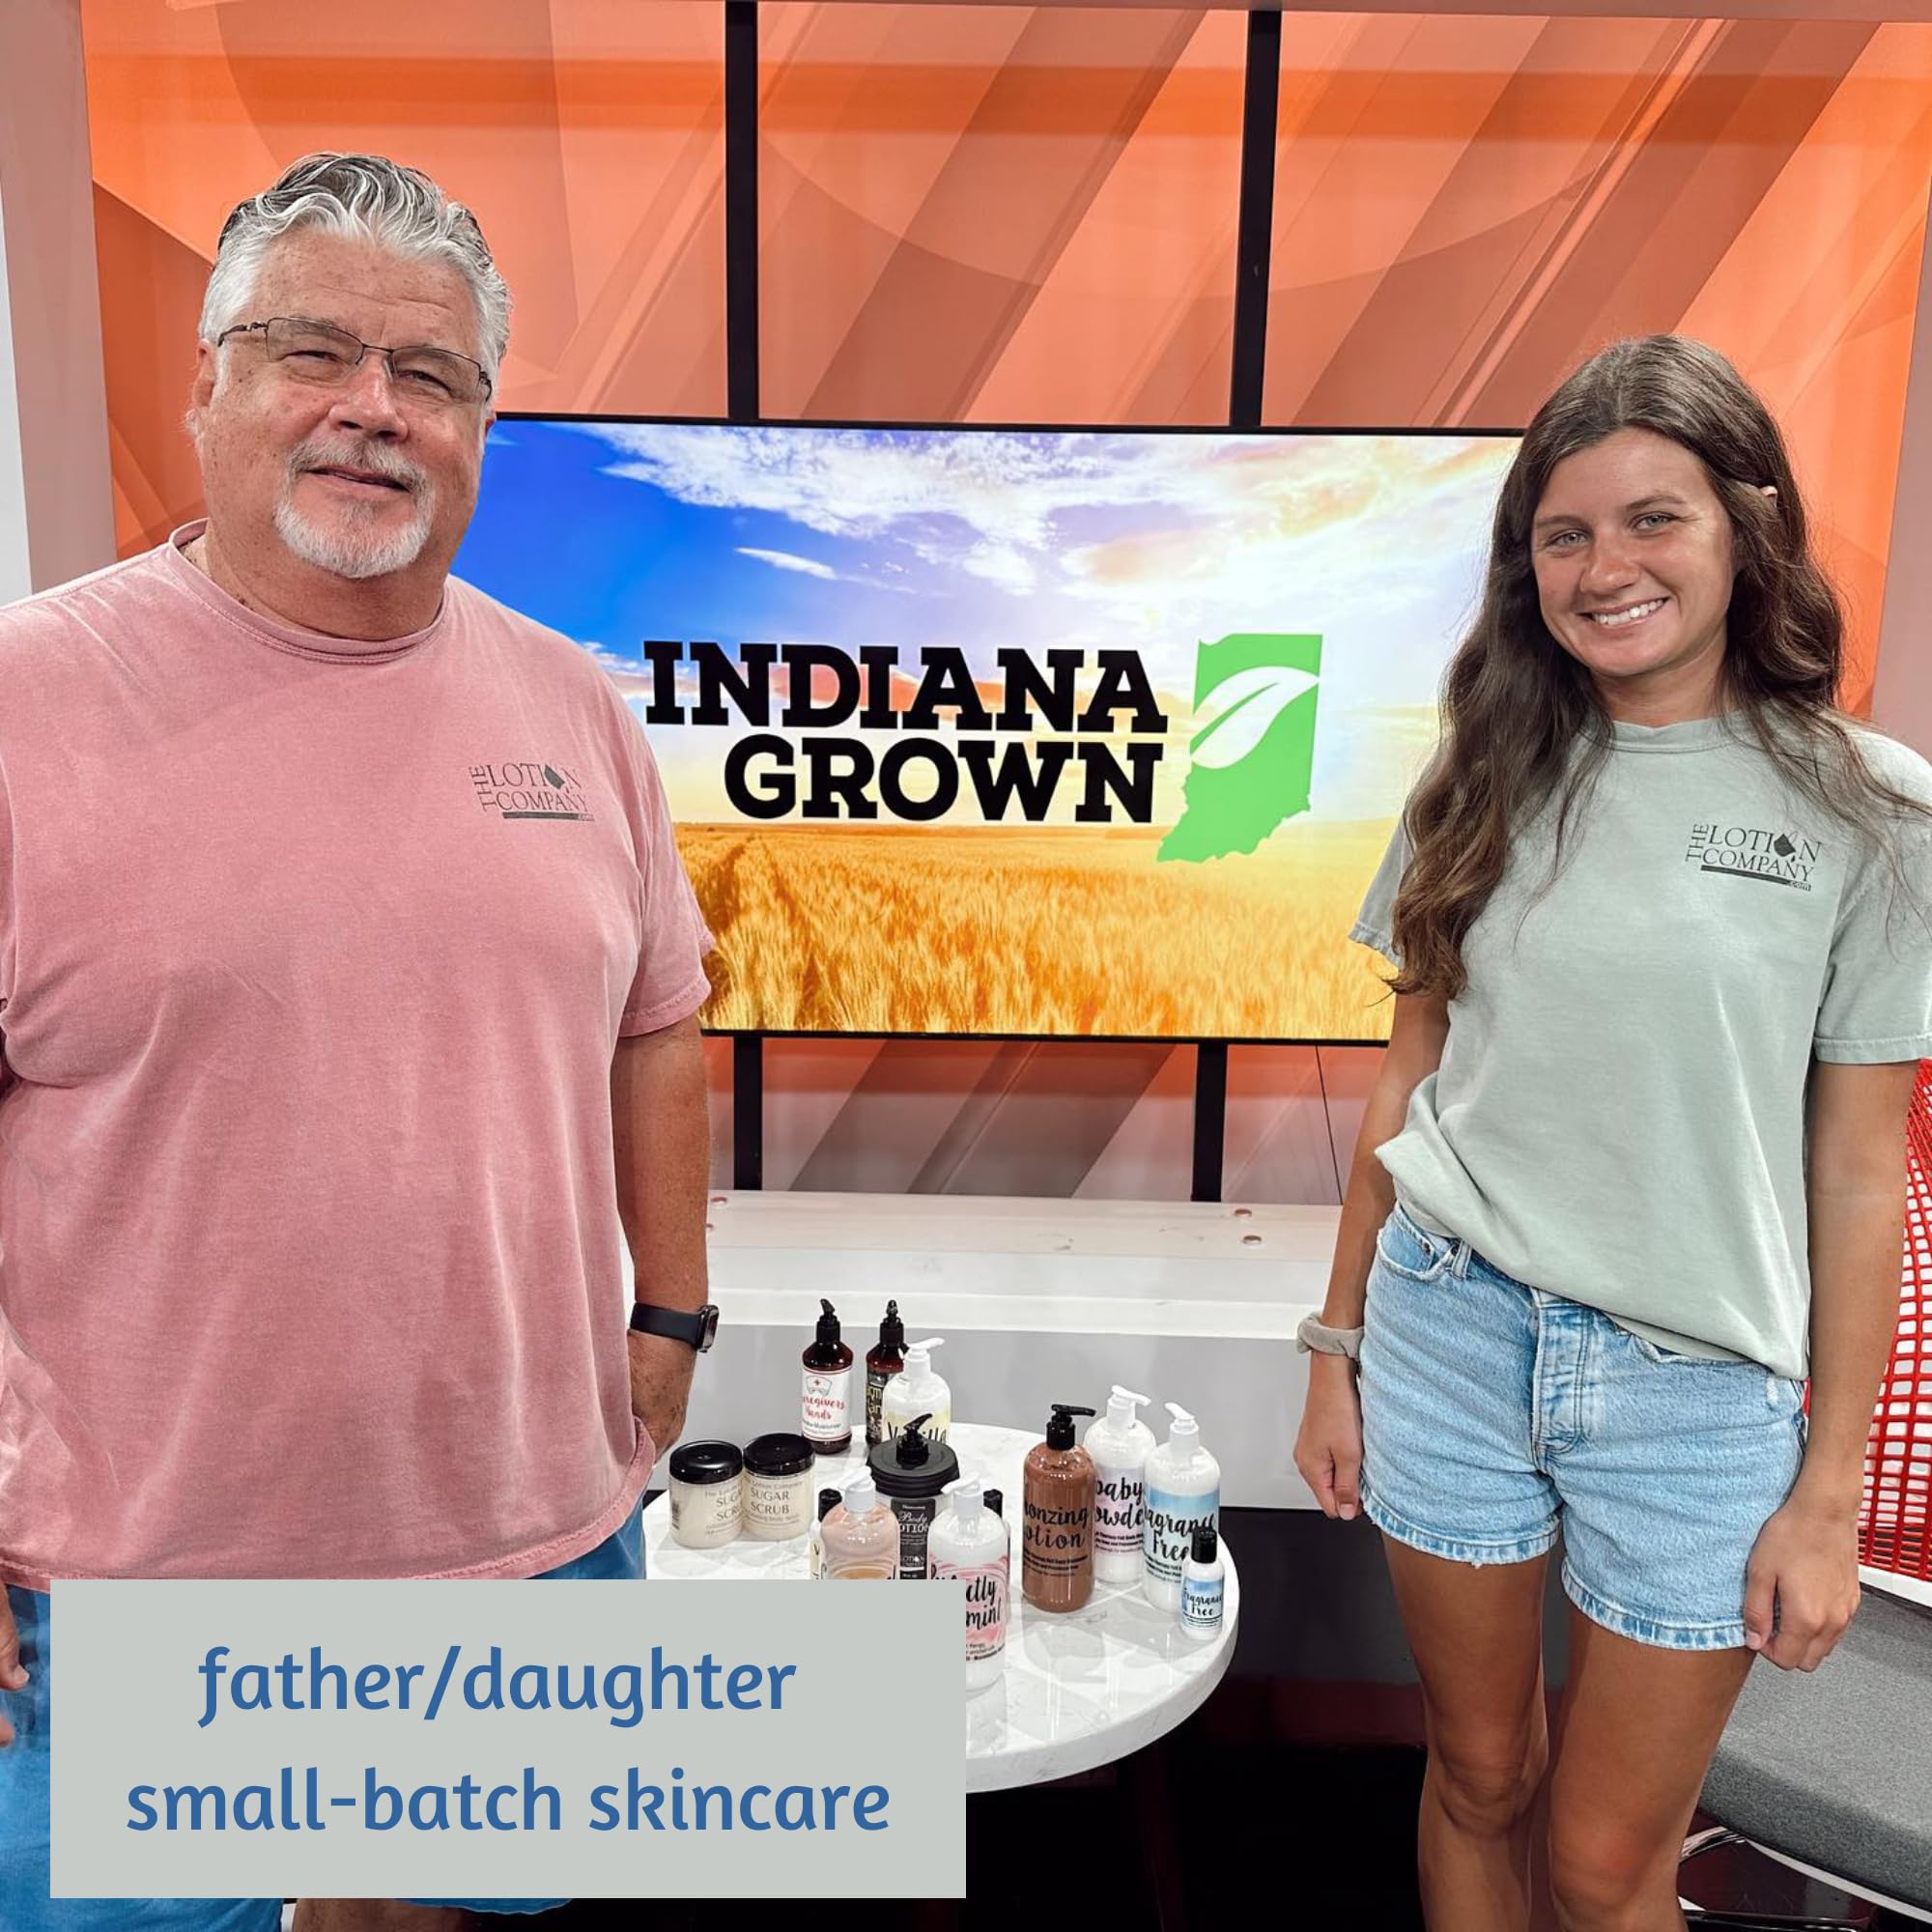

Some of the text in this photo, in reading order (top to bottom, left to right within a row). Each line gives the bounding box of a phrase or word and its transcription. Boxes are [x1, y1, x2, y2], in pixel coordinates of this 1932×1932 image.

[643, 640, 1168, 733] INDIANA
[468, 764, 497, 811] THE
[724, 734, 1163, 823] GROWN
[496, 791, 587, 812] COMPANY
[1685, 823, 1709, 862] THE
[1702, 847, 1813, 882] COMPANY
[751, 1487, 790, 1500] SUGAR
[751, 1500, 790, 1515] SCRUB
